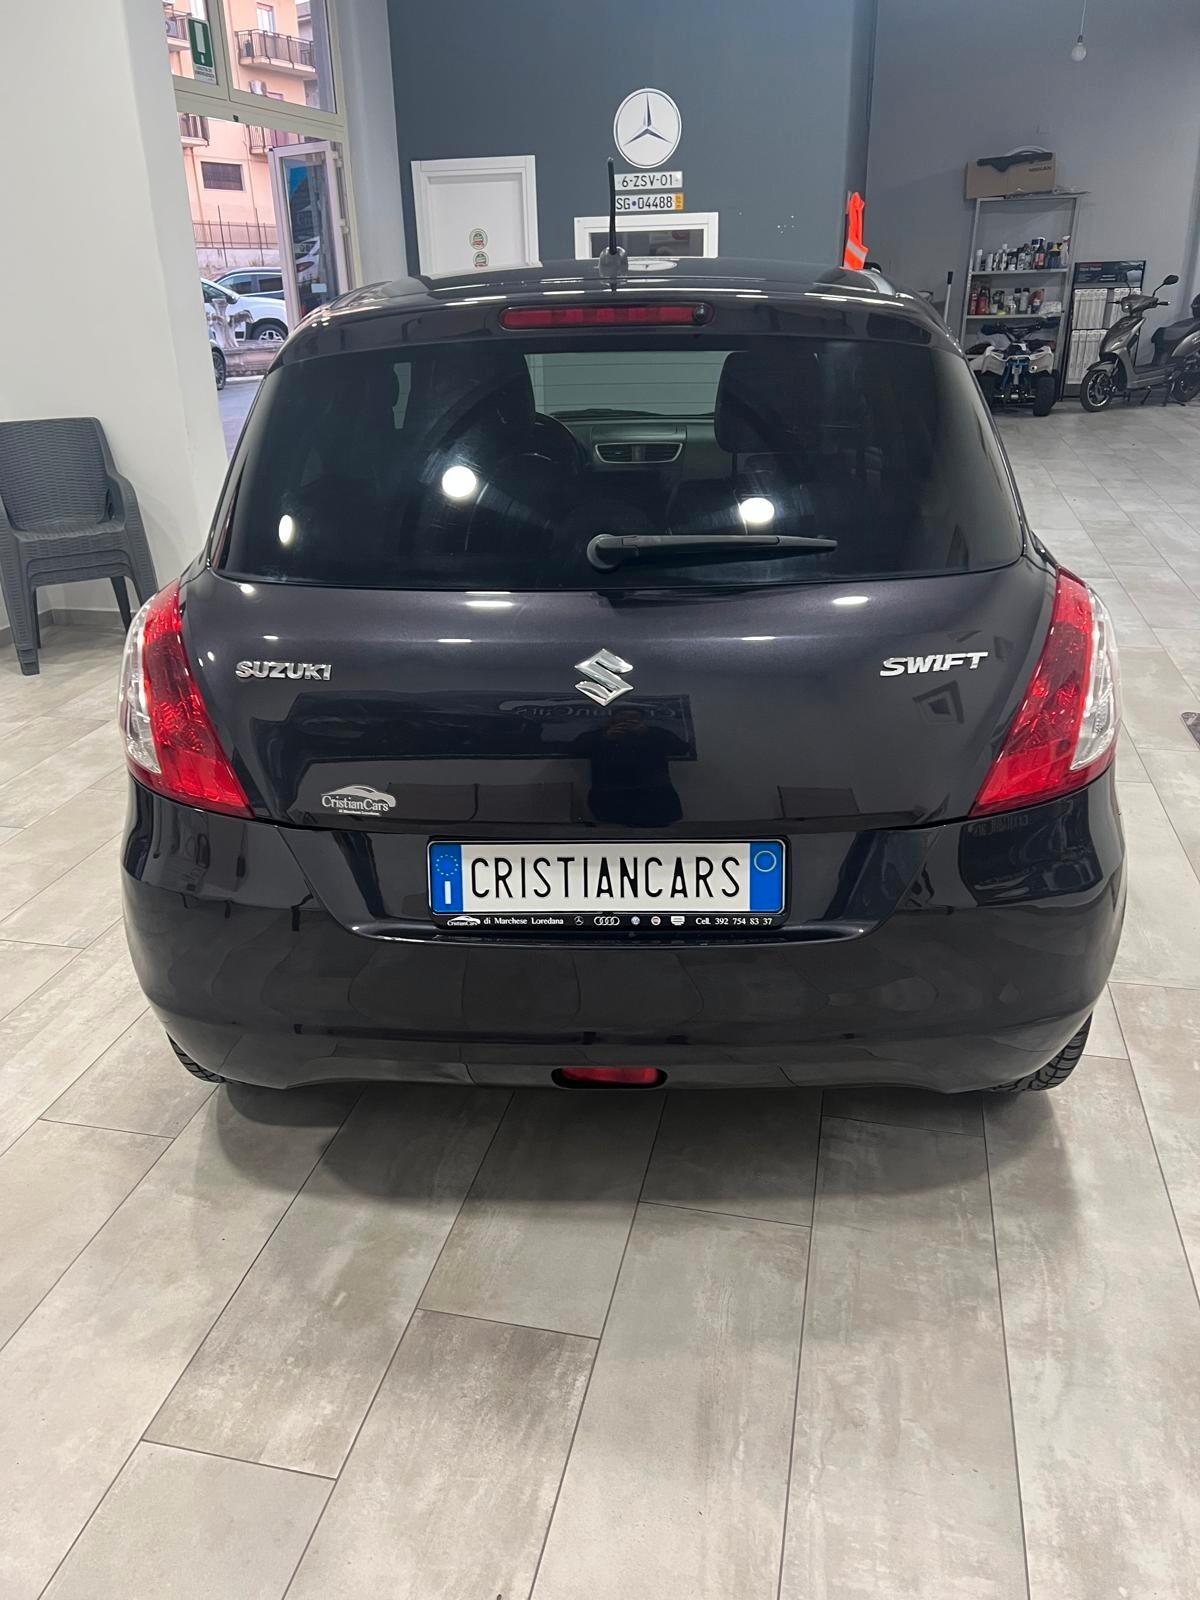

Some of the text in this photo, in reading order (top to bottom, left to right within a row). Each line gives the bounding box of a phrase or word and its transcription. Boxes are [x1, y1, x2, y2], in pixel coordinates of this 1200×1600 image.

[621, 174, 673, 188] 6-ZSV-01
[235, 660, 332, 681] SUZUKI
[879, 651, 989, 677] SWIFT
[321, 795, 389, 812] CristianCars
[470, 856, 741, 899] CRISTIANCARS
[483, 917, 491, 925] di
[494, 917, 528, 925] Marchese
[531, 917, 564, 925] Loredana
[715, 917, 729, 925] 392
[732, 917, 746, 925] 754
[749, 917, 760, 925] 83
[762, 917, 773, 925] 37
